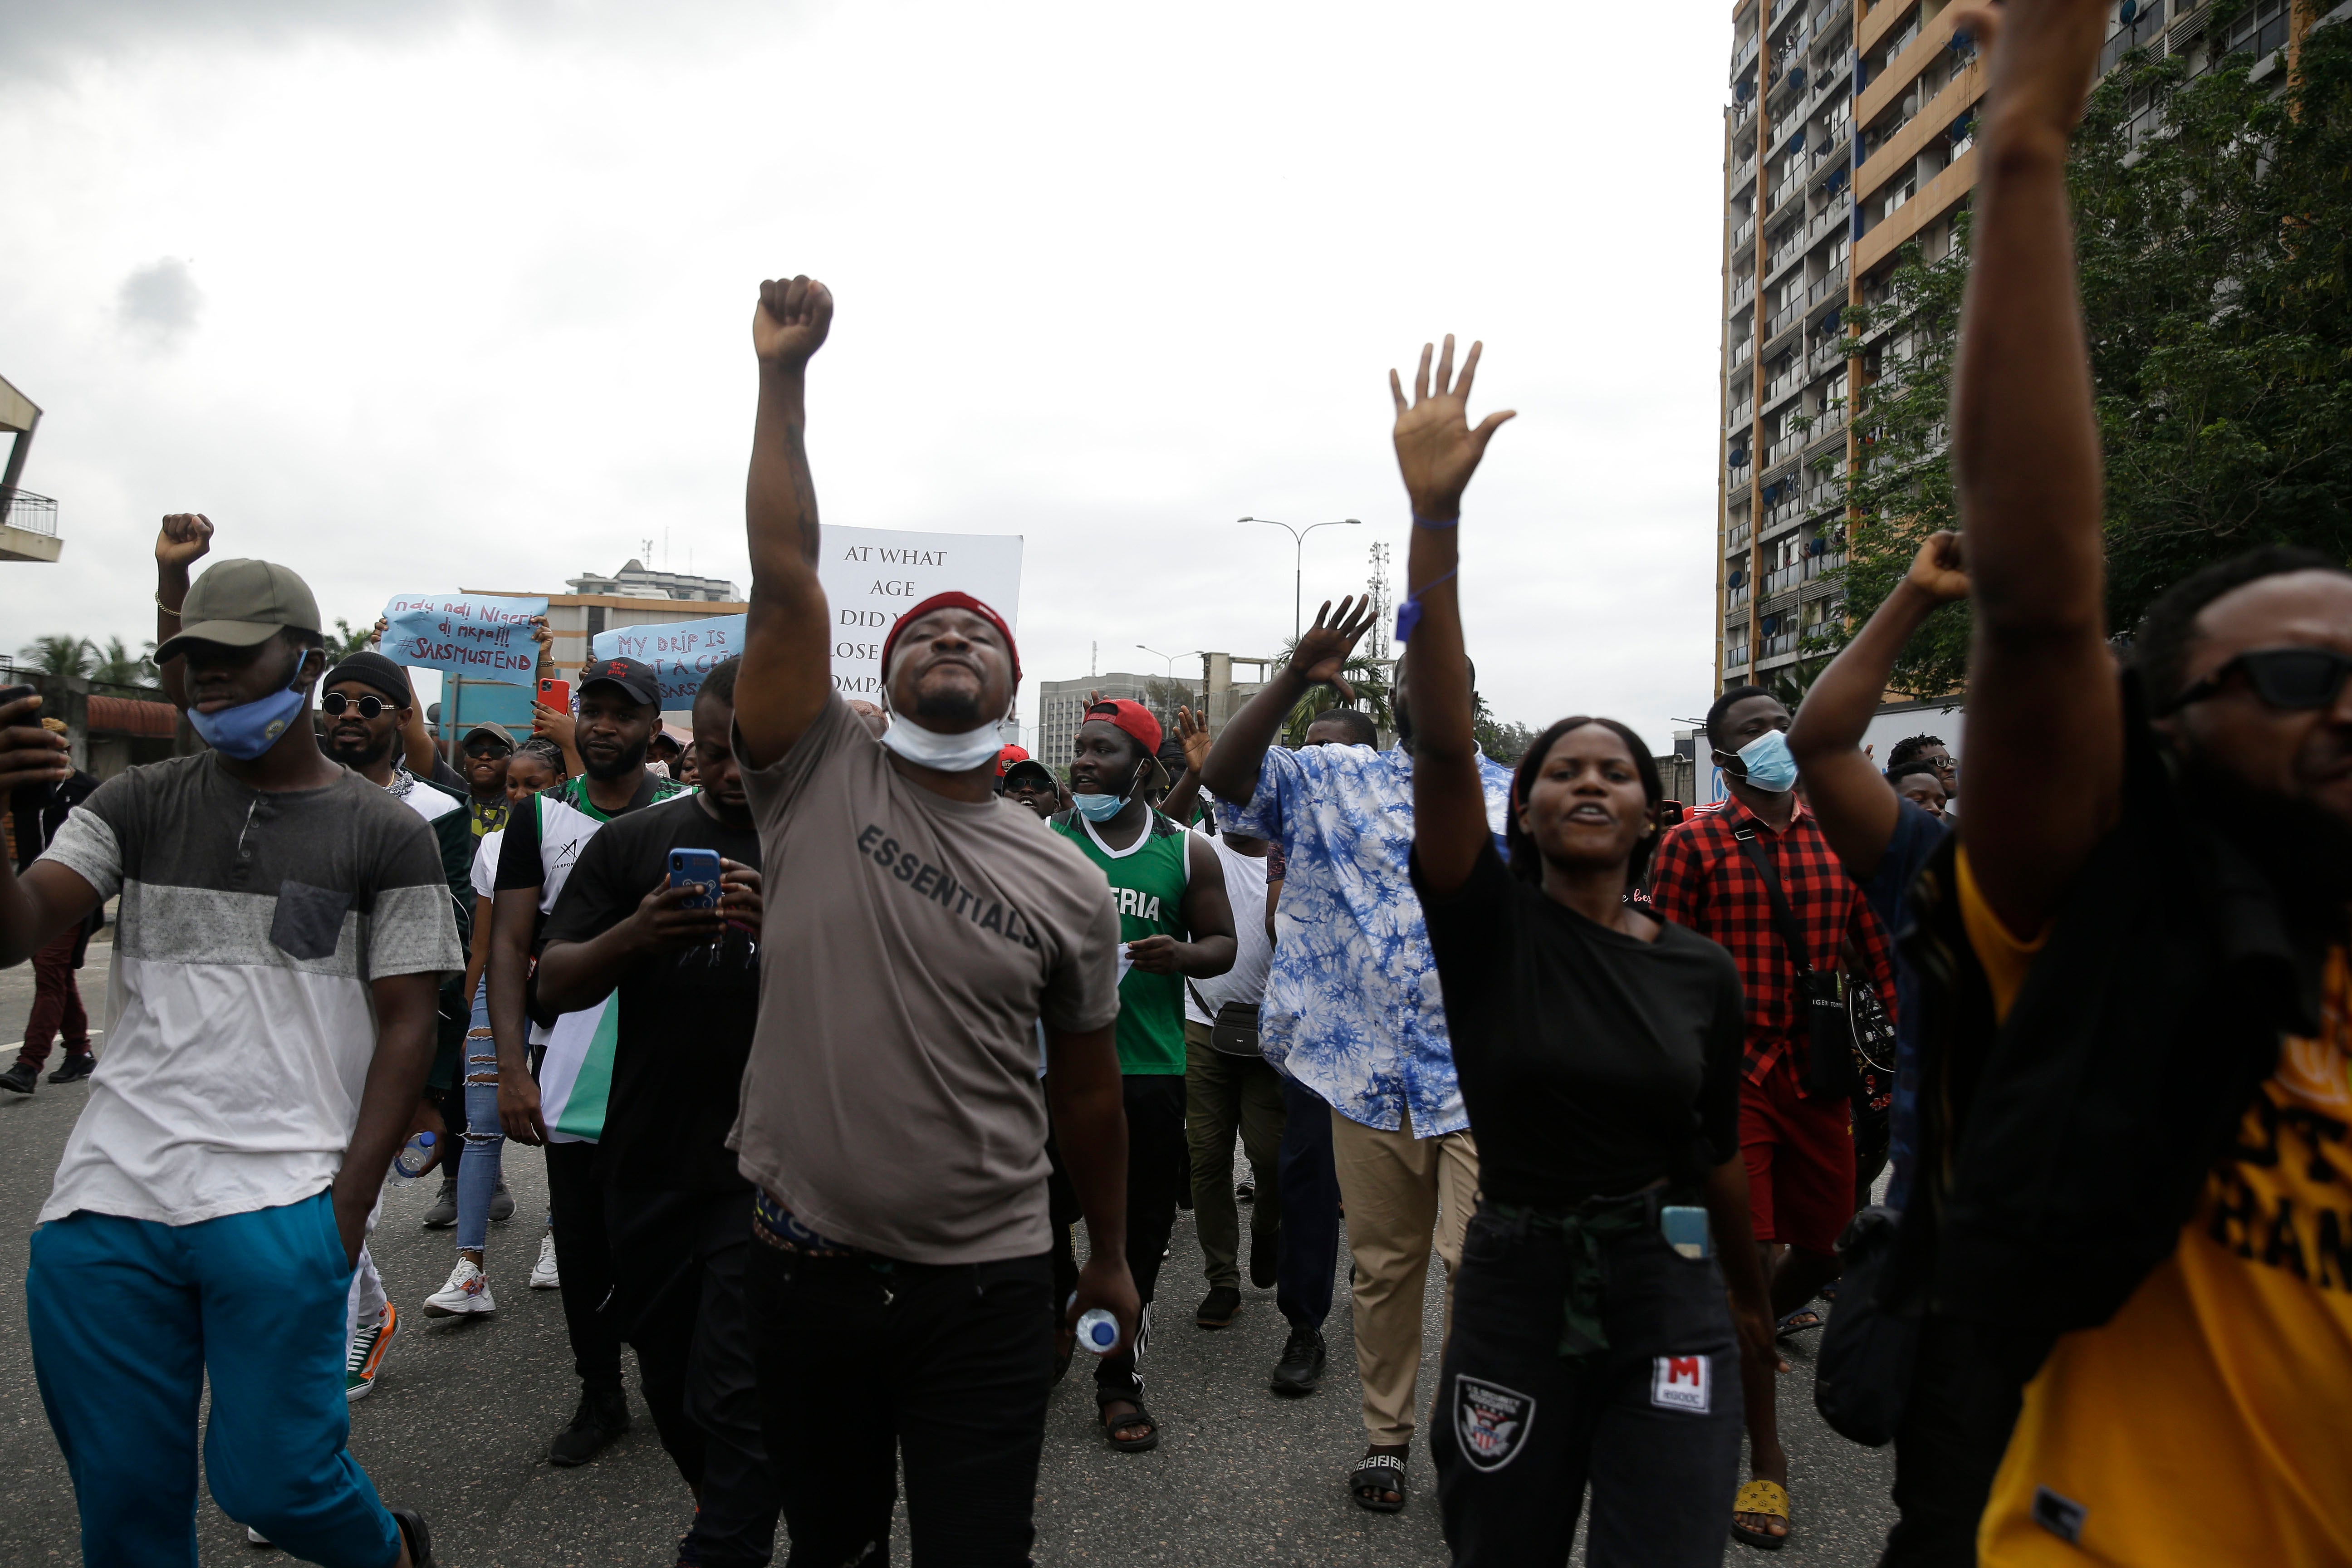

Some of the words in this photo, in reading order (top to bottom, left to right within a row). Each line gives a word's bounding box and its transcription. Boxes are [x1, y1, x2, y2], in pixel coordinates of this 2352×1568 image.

[843, 545, 873, 562] AT
[878, 548, 948, 566] WHAT
[868, 579, 915, 597] AGE
[840, 609, 885, 627] DID
[458, 624, 510, 648] mkpa!!!
[618, 635, 648, 657] MY
[657, 630, 699, 654] DRIP
[705, 629, 726, 647] IS
[829, 642, 879, 660] OSE
[647, 658, 665, 675] OT
[673, 658, 689, 675] A
[659, 682, 702, 698] SARS
[858, 824, 1041, 949] ESSENTIALS
[1633, 889, 1652, 904] bes
[1668, 1356, 1699, 1387] M
